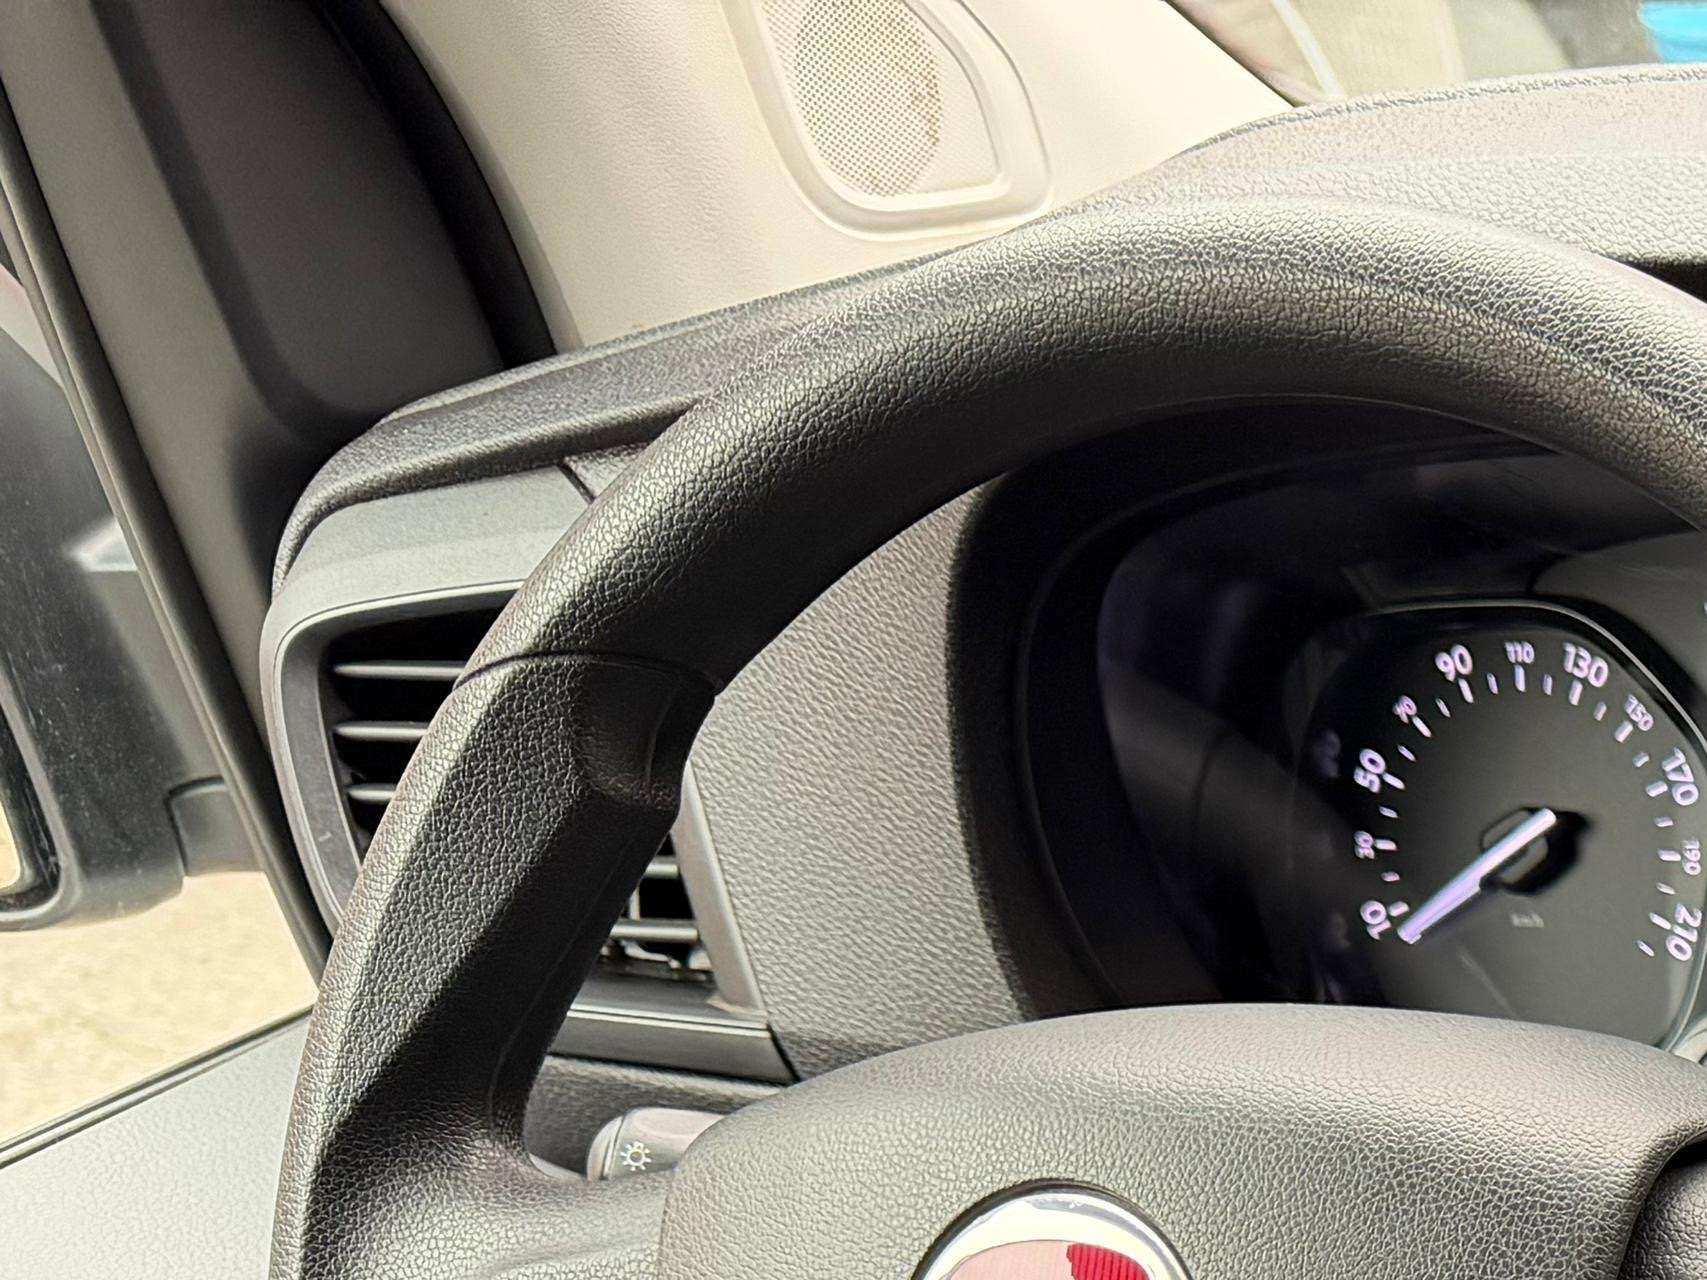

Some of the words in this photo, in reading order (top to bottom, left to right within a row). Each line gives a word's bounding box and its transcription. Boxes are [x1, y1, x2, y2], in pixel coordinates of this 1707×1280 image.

[1435, 644, 1474, 682] 90
[1504, 641, 1535, 664] 110
[1563, 642, 1609, 688] 130
[1624, 694, 1654, 731] 150
[1353, 749, 1386, 794] 50
[1662, 746, 1700, 806] 170
[1354, 830, 1375, 859] 30
[1681, 838, 1701, 876] 190
[1360, 900, 1392, 940] 10
[1666, 903, 1702, 962] 210
